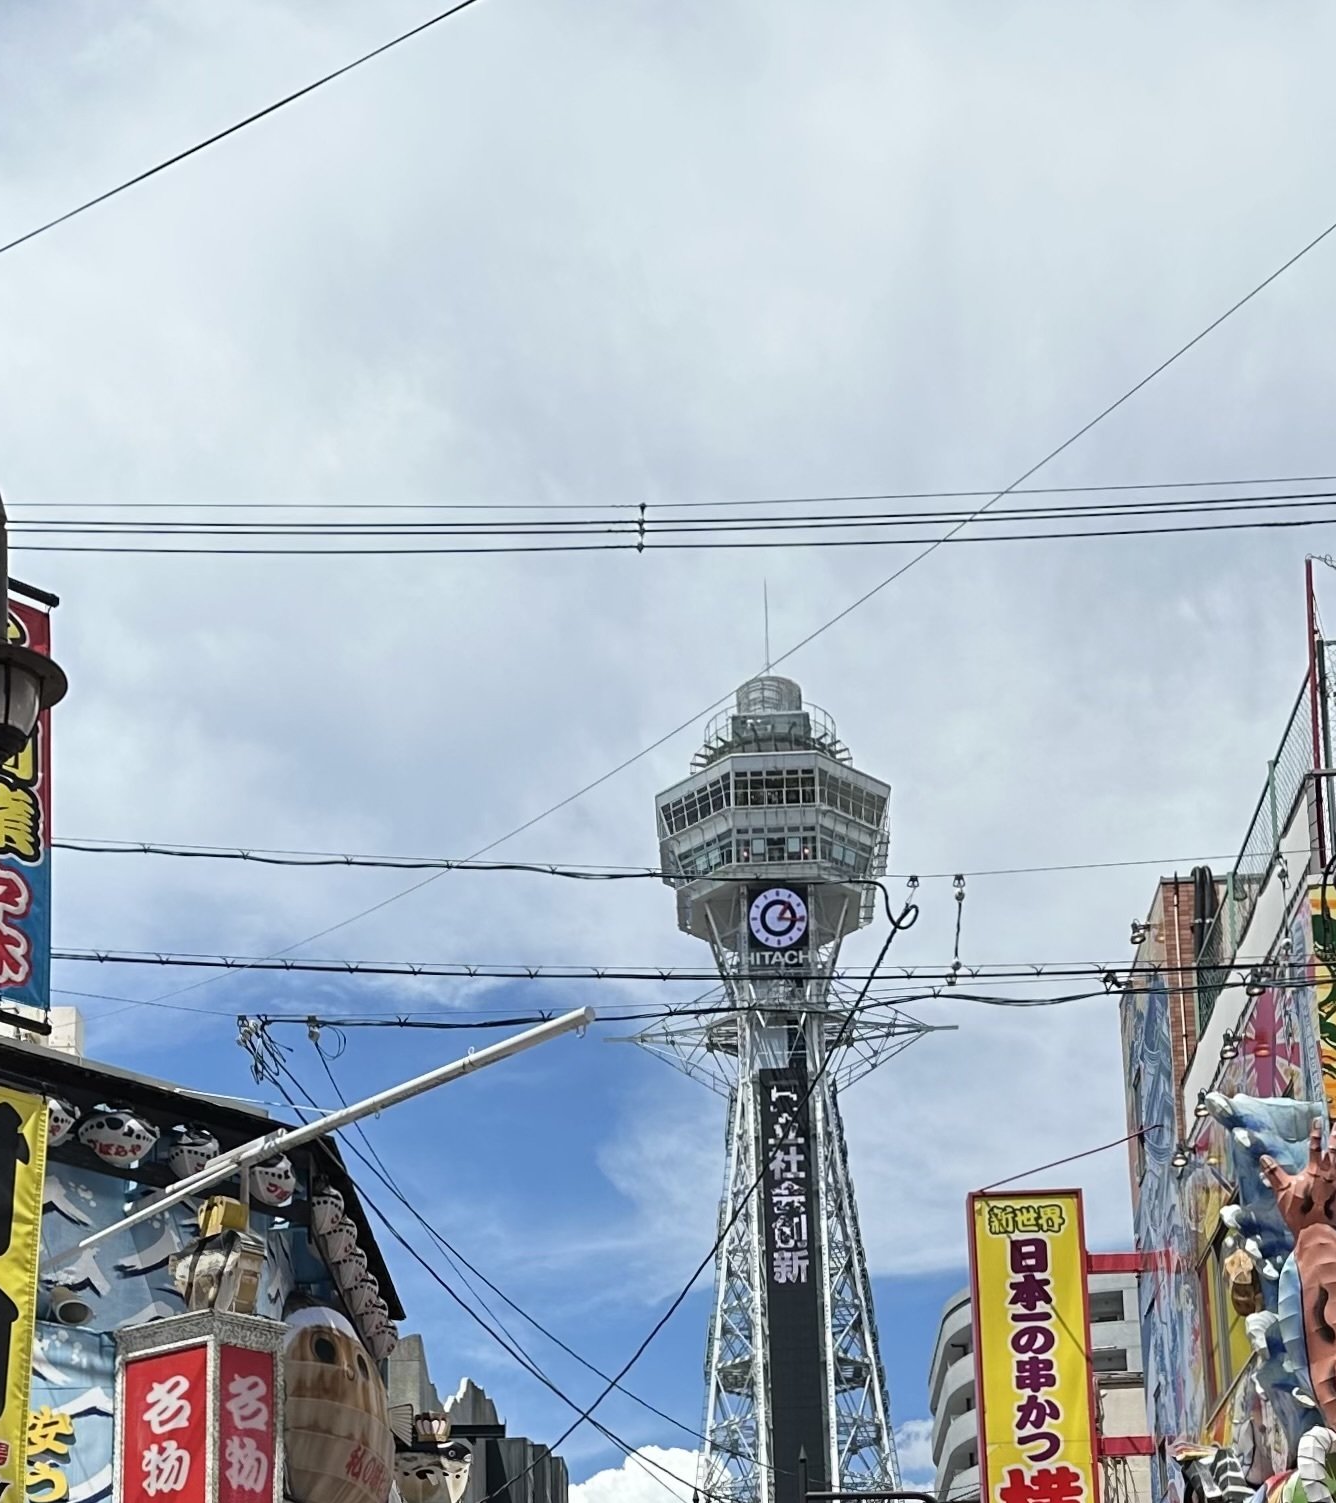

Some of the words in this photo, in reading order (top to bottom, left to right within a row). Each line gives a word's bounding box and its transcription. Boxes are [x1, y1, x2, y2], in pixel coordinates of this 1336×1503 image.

[986, 1203, 1067, 1236] 新世界
[1008, 1238, 1059, 1463] 日本一の串かつ
